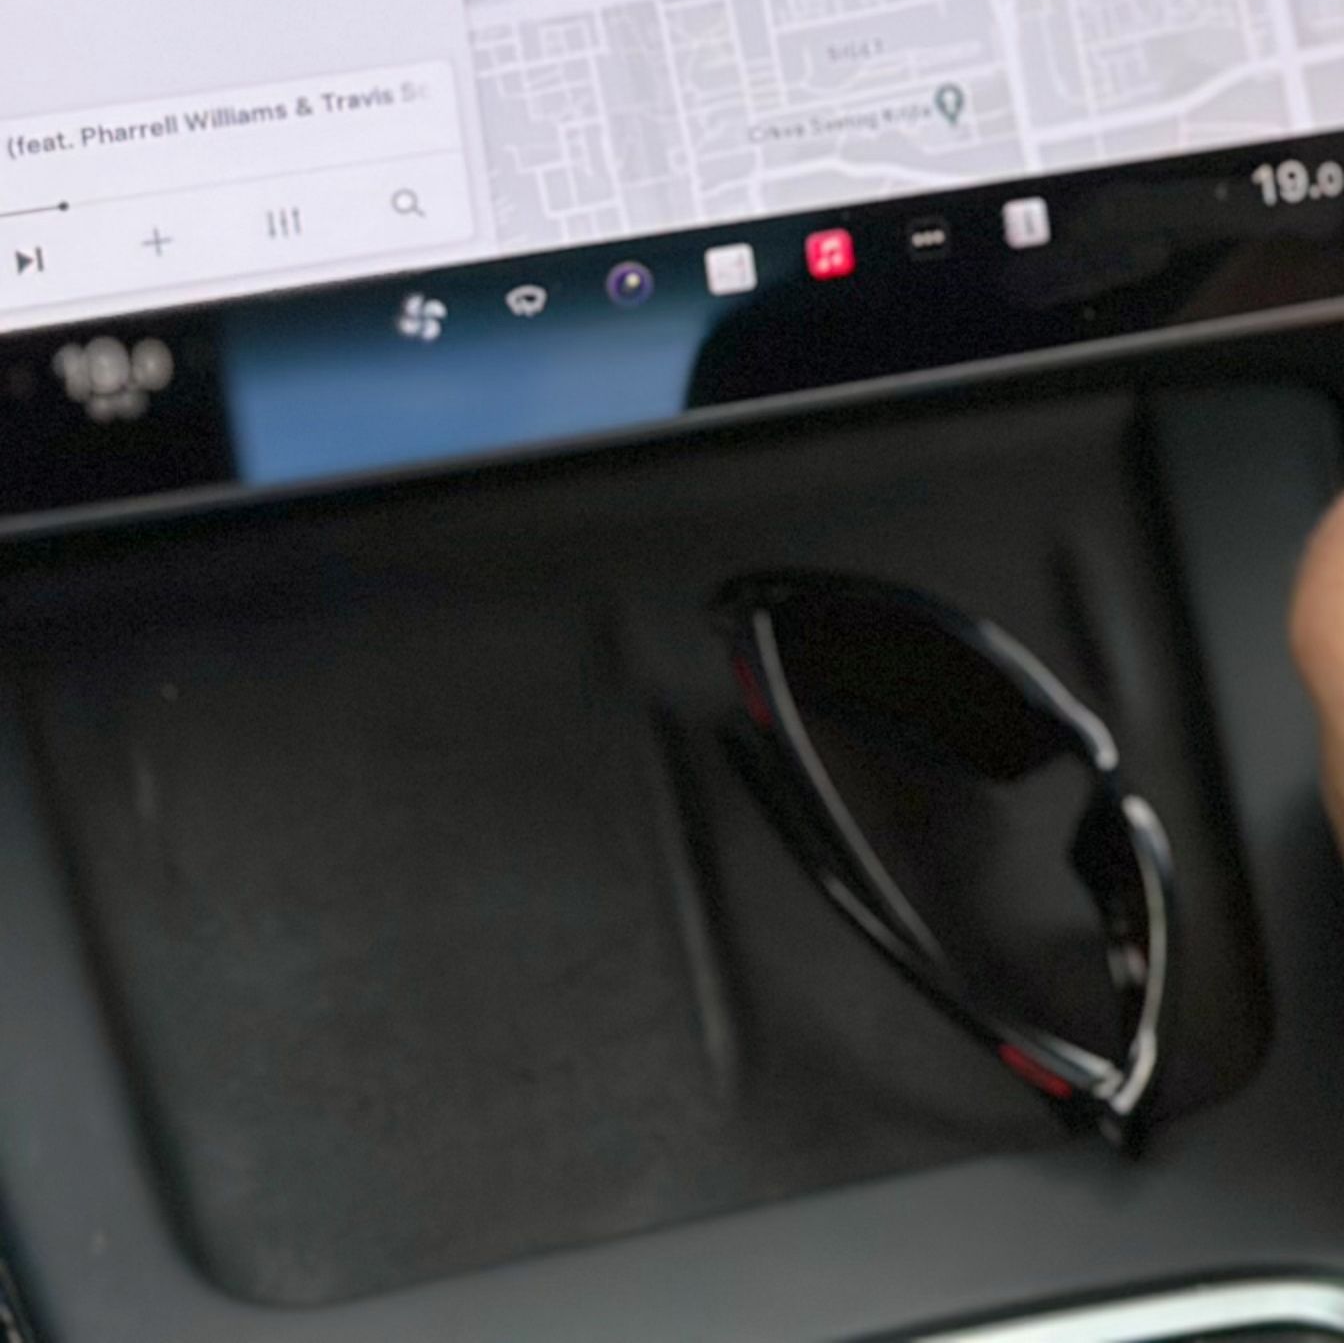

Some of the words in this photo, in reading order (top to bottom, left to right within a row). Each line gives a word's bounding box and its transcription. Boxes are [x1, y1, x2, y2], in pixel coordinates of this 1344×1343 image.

[7, 134, 74, 159] (feat.
[80, 115, 179, 146] Pharrell
[184, 103, 288, 133] Williams
[295, 95, 314, 116] &
[320, 84, 394, 112] Travis
[1251, 159, 1344, 206] 19.0
